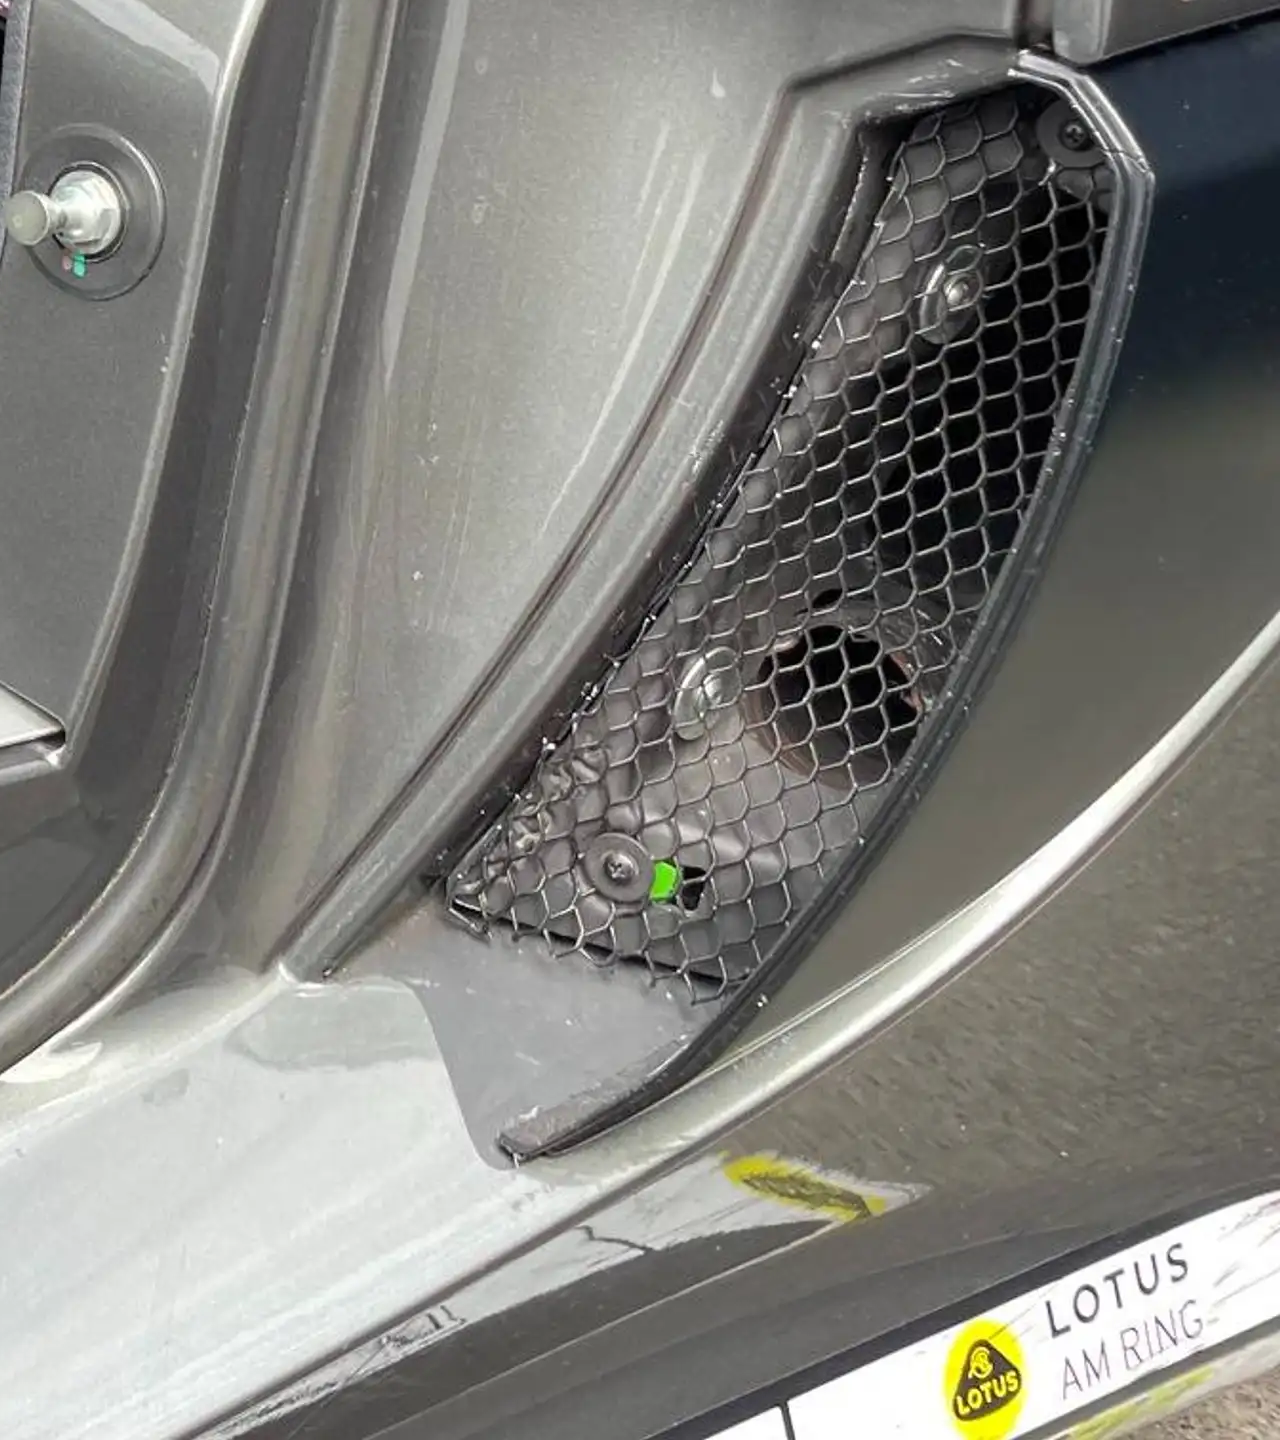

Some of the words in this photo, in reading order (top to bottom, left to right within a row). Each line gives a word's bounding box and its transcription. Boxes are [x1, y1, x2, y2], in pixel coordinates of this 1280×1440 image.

[1045, 1242, 1189, 1339] LOTUS
[954, 1369, 1020, 1416] LOTUS
[1061, 1337, 1112, 1401] AM
[1120, 1298, 1204, 1372] RING
